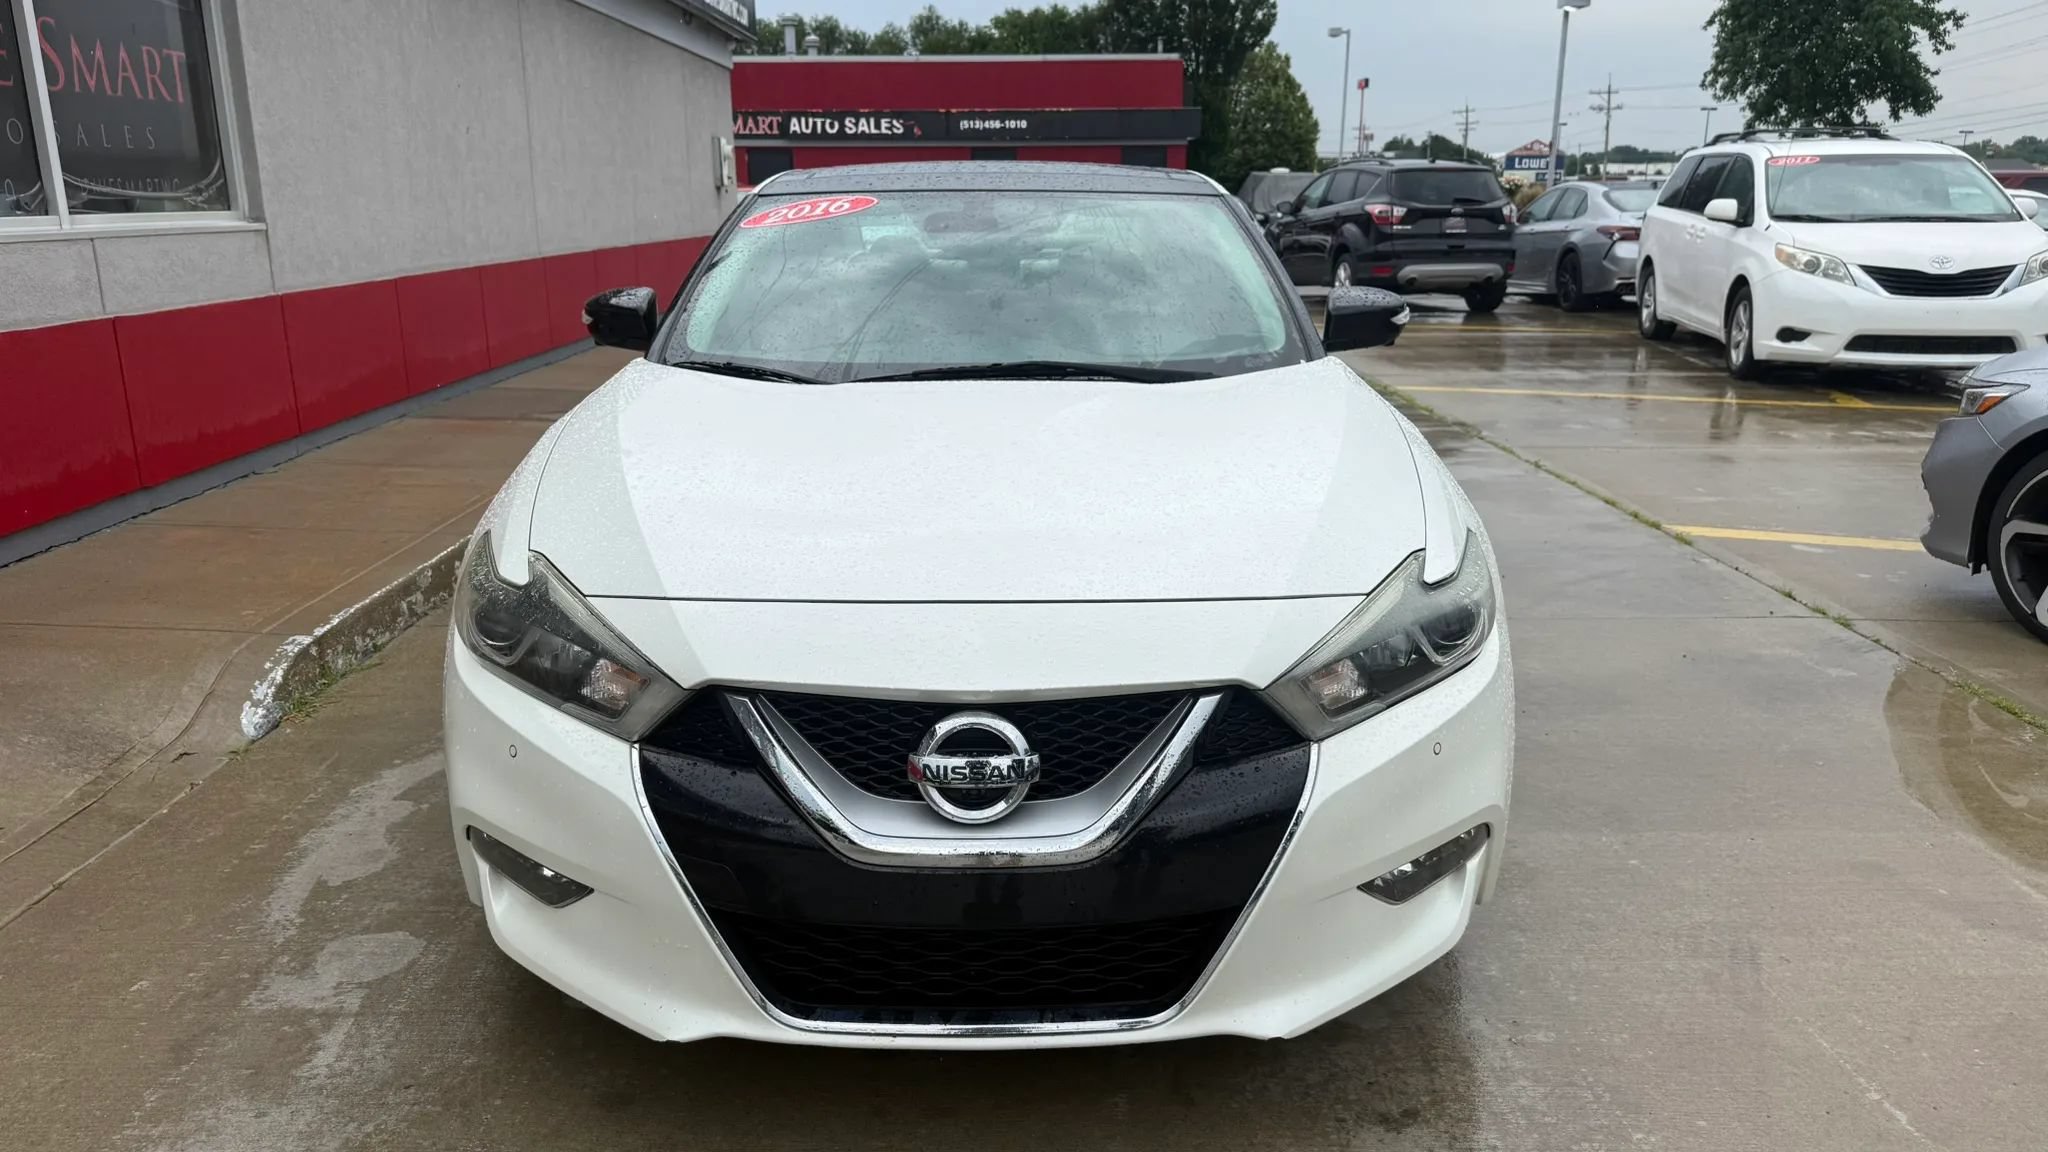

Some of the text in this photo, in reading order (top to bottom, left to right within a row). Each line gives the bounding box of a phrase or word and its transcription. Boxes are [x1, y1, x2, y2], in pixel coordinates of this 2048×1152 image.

[37, 16, 186, 103] SMART
[789, 116, 839, 134] AUTO
[844, 116, 904, 135] SALES
[959, 119, 1028, 131] (513)456-1010
[762, 199, 851, 225] 2016
[921, 758, 1026, 783] NISSAN
